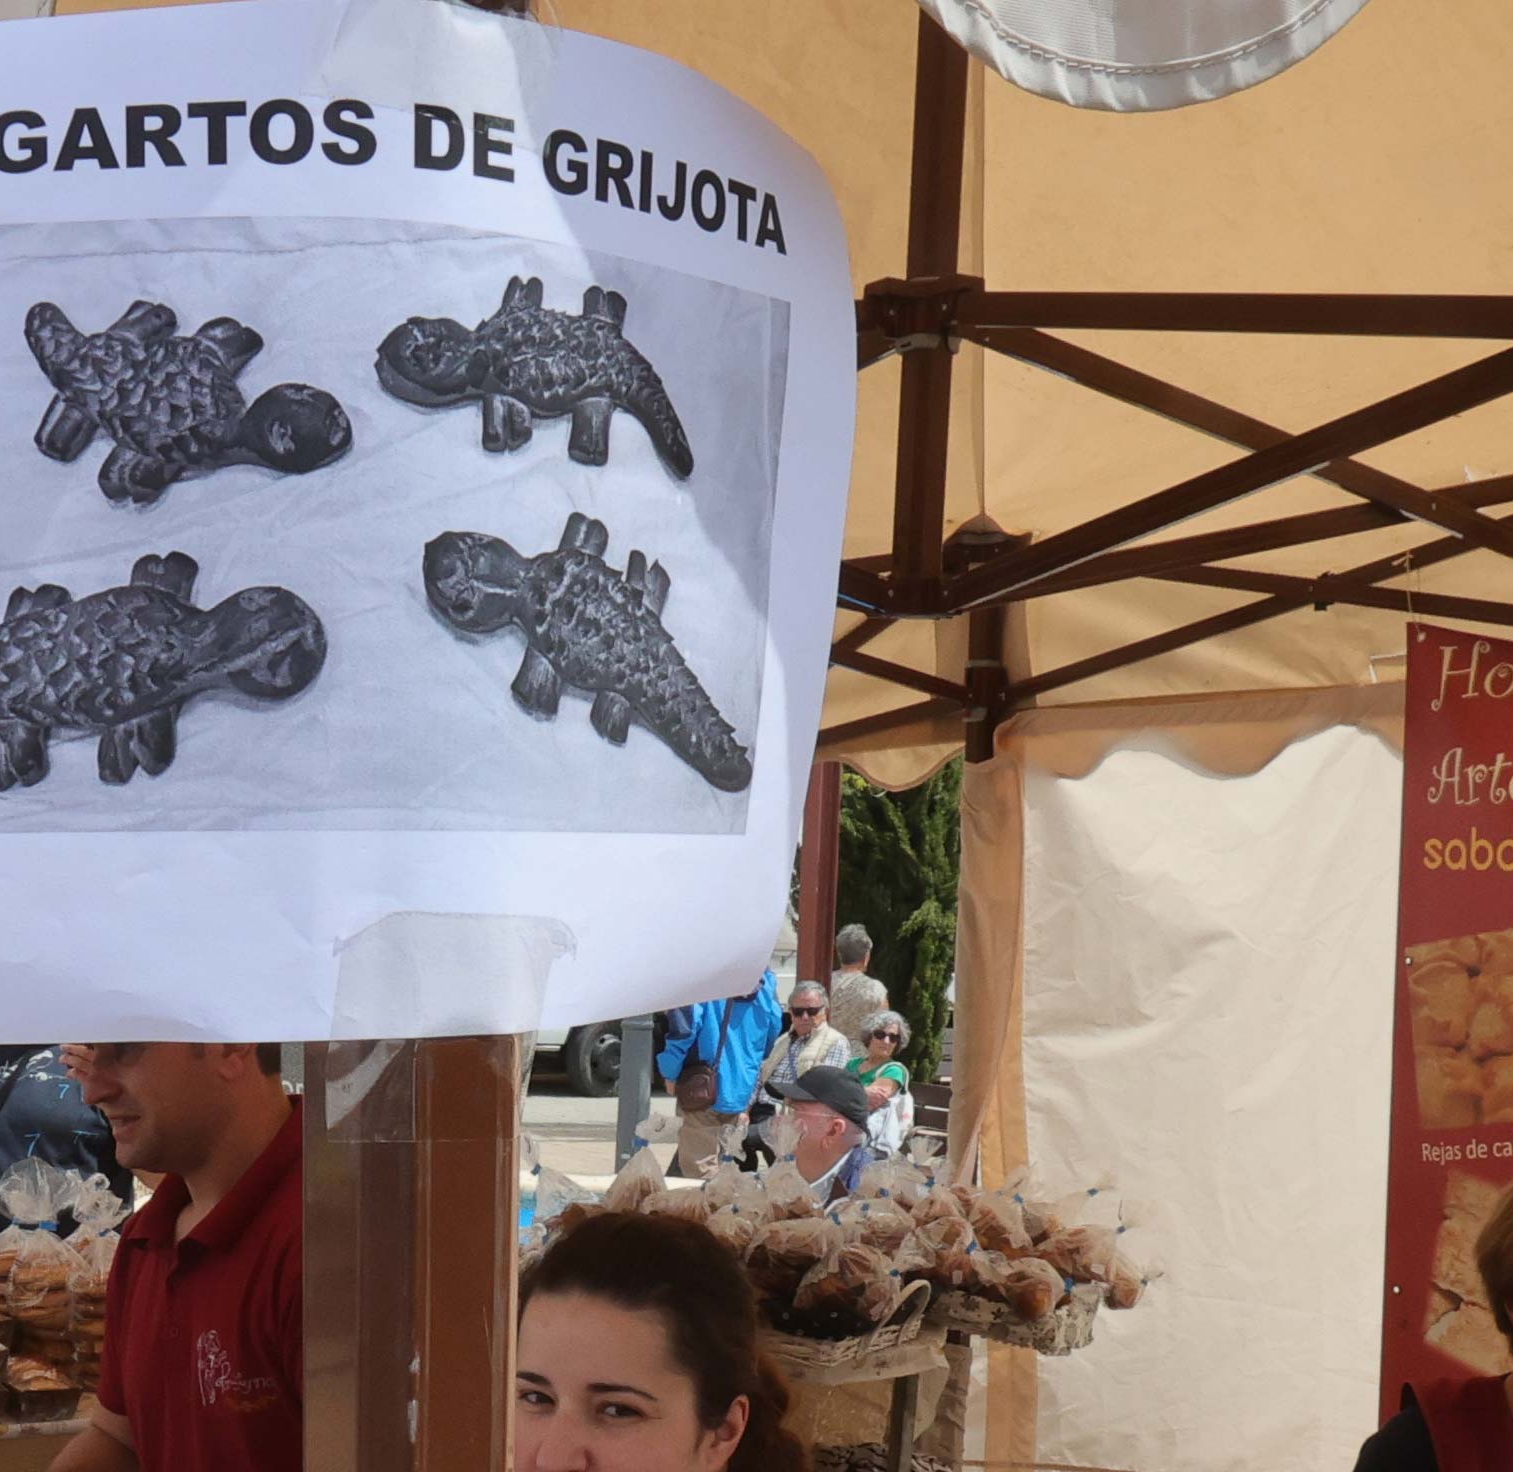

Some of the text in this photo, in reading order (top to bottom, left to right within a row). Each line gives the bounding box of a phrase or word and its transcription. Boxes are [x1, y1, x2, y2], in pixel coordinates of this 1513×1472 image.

[414, 103, 516, 183] DE
[542, 129, 788, 256] GRIJOTA
[1422, 1142, 1462, 1165] Rejas
[1466, 1138, 1487, 1159] de
